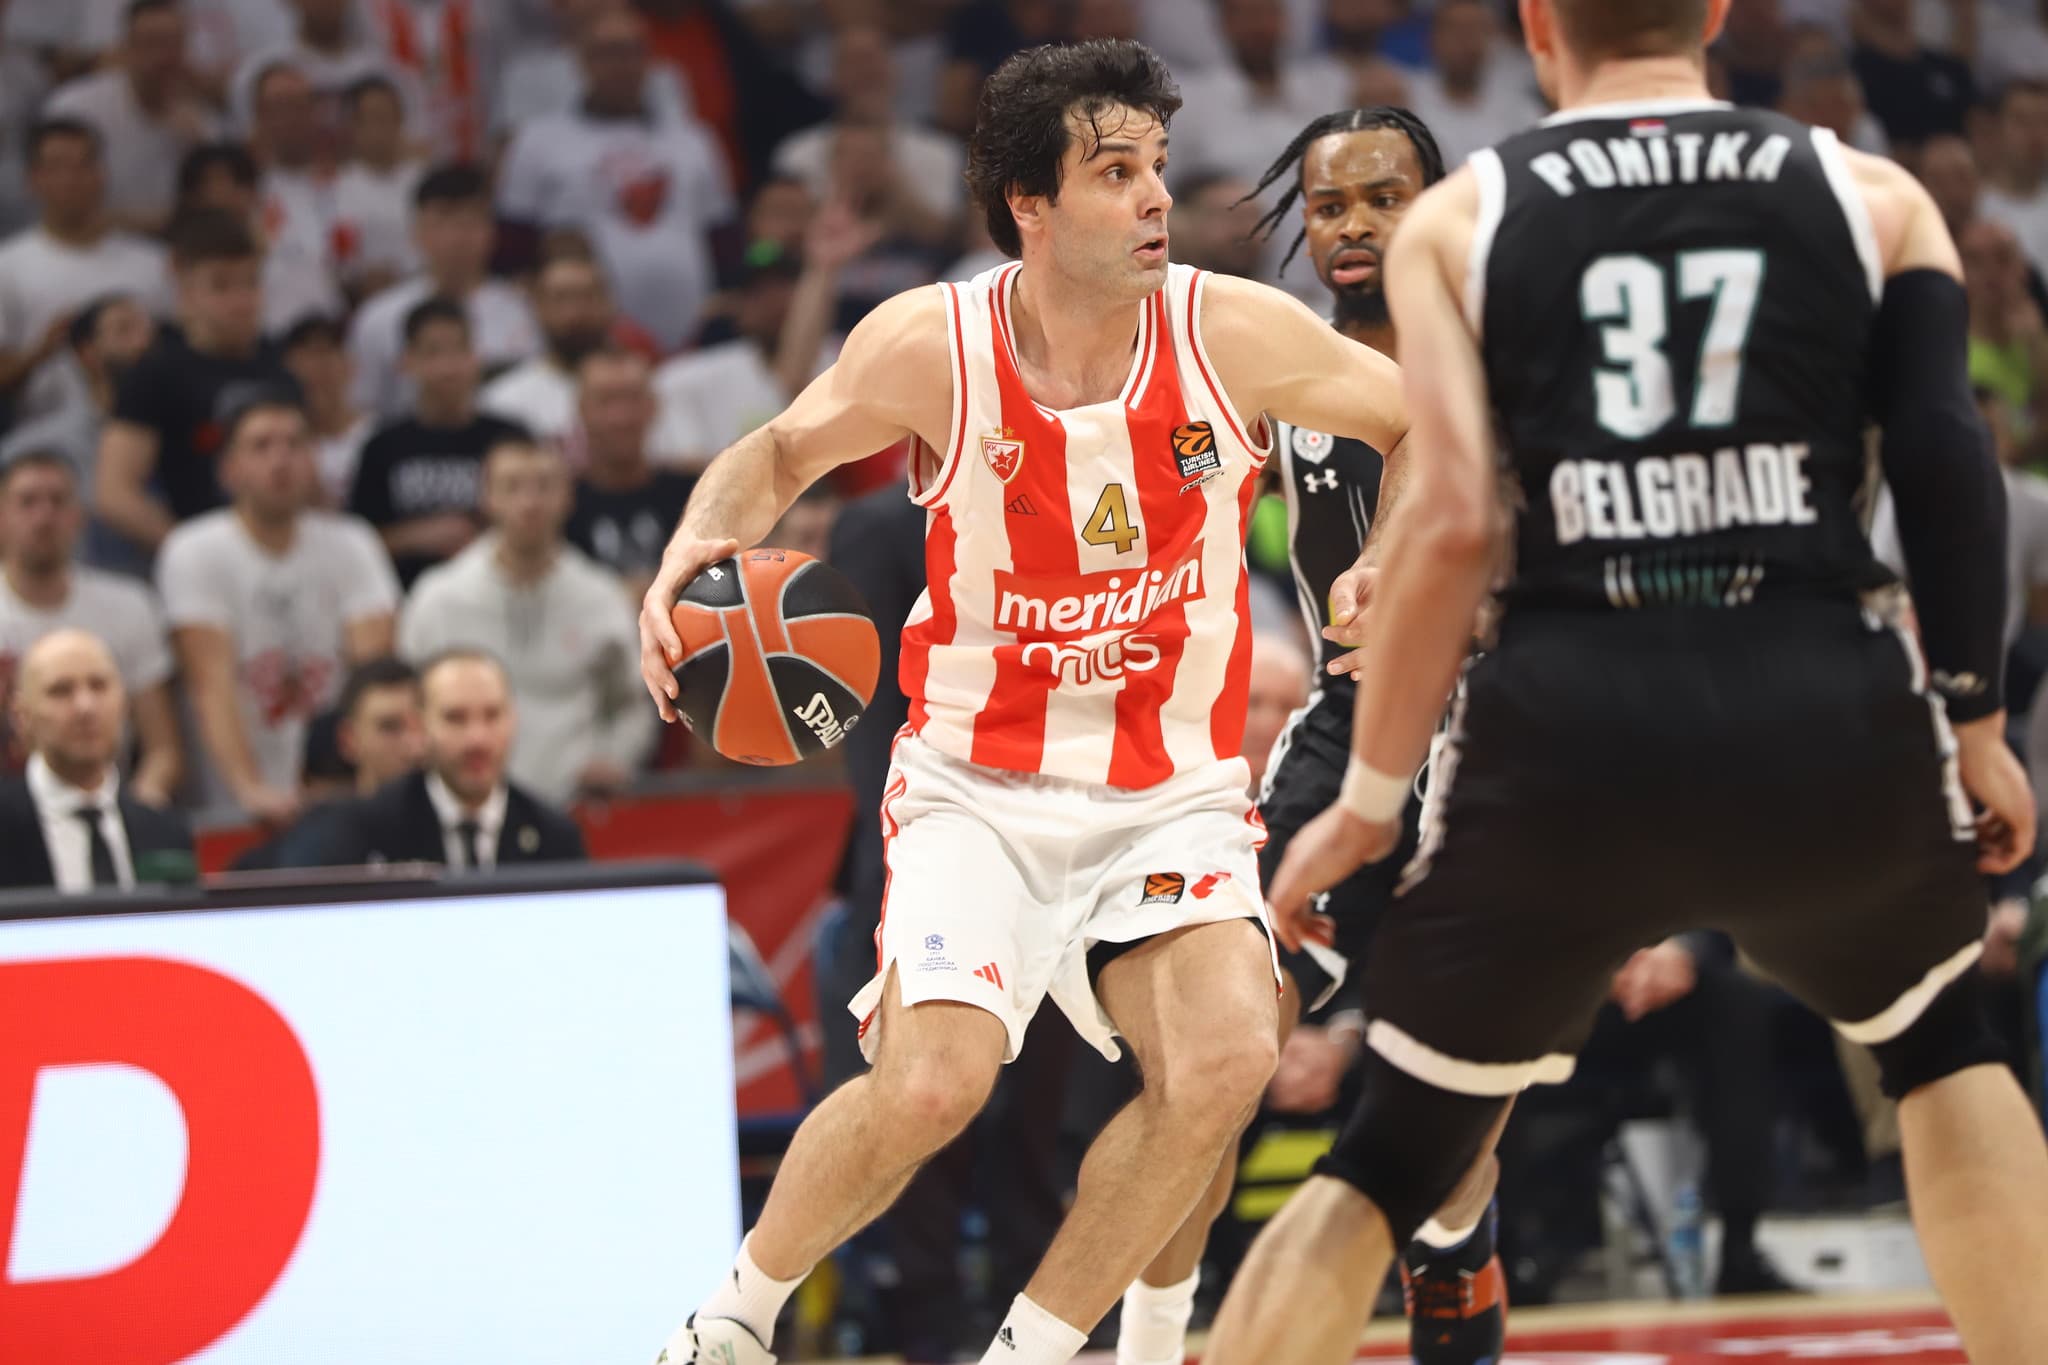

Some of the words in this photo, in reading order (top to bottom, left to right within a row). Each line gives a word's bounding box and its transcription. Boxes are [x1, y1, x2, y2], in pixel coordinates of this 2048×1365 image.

[1529, 131, 1791, 197] PONITKA
[1580, 248, 1766, 441] 37
[1180, 450, 1215, 466] TURKISH
[1183, 456, 1216, 473] AIRLINES
[1081, 483, 1139, 554] 4
[1549, 442, 1817, 545] BELGRADE
[998, 558, 1199, 633] meridian
[793, 692, 845, 749] SPAL
